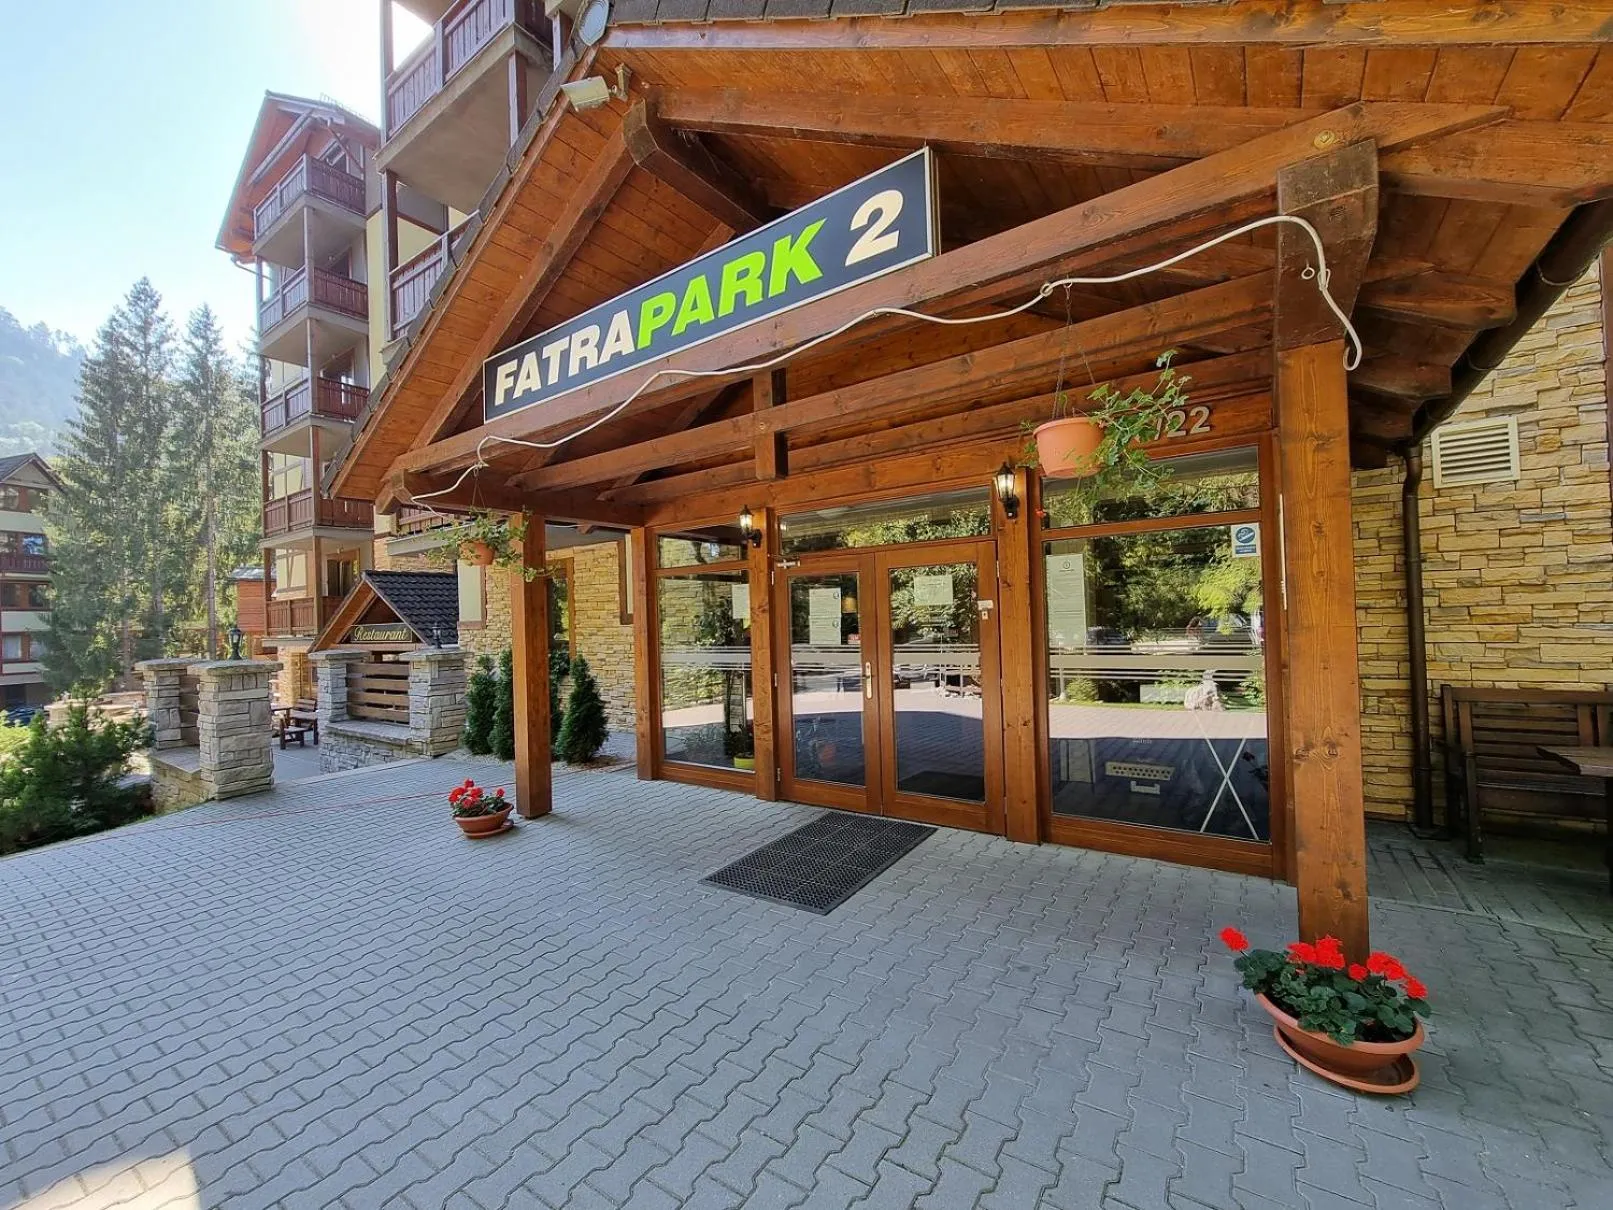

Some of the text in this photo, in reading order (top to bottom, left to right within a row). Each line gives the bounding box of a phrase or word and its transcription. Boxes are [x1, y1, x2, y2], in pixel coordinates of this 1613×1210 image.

[494, 189, 904, 407] FATRAPARK 2
[354, 626, 409, 641] Restaurant
